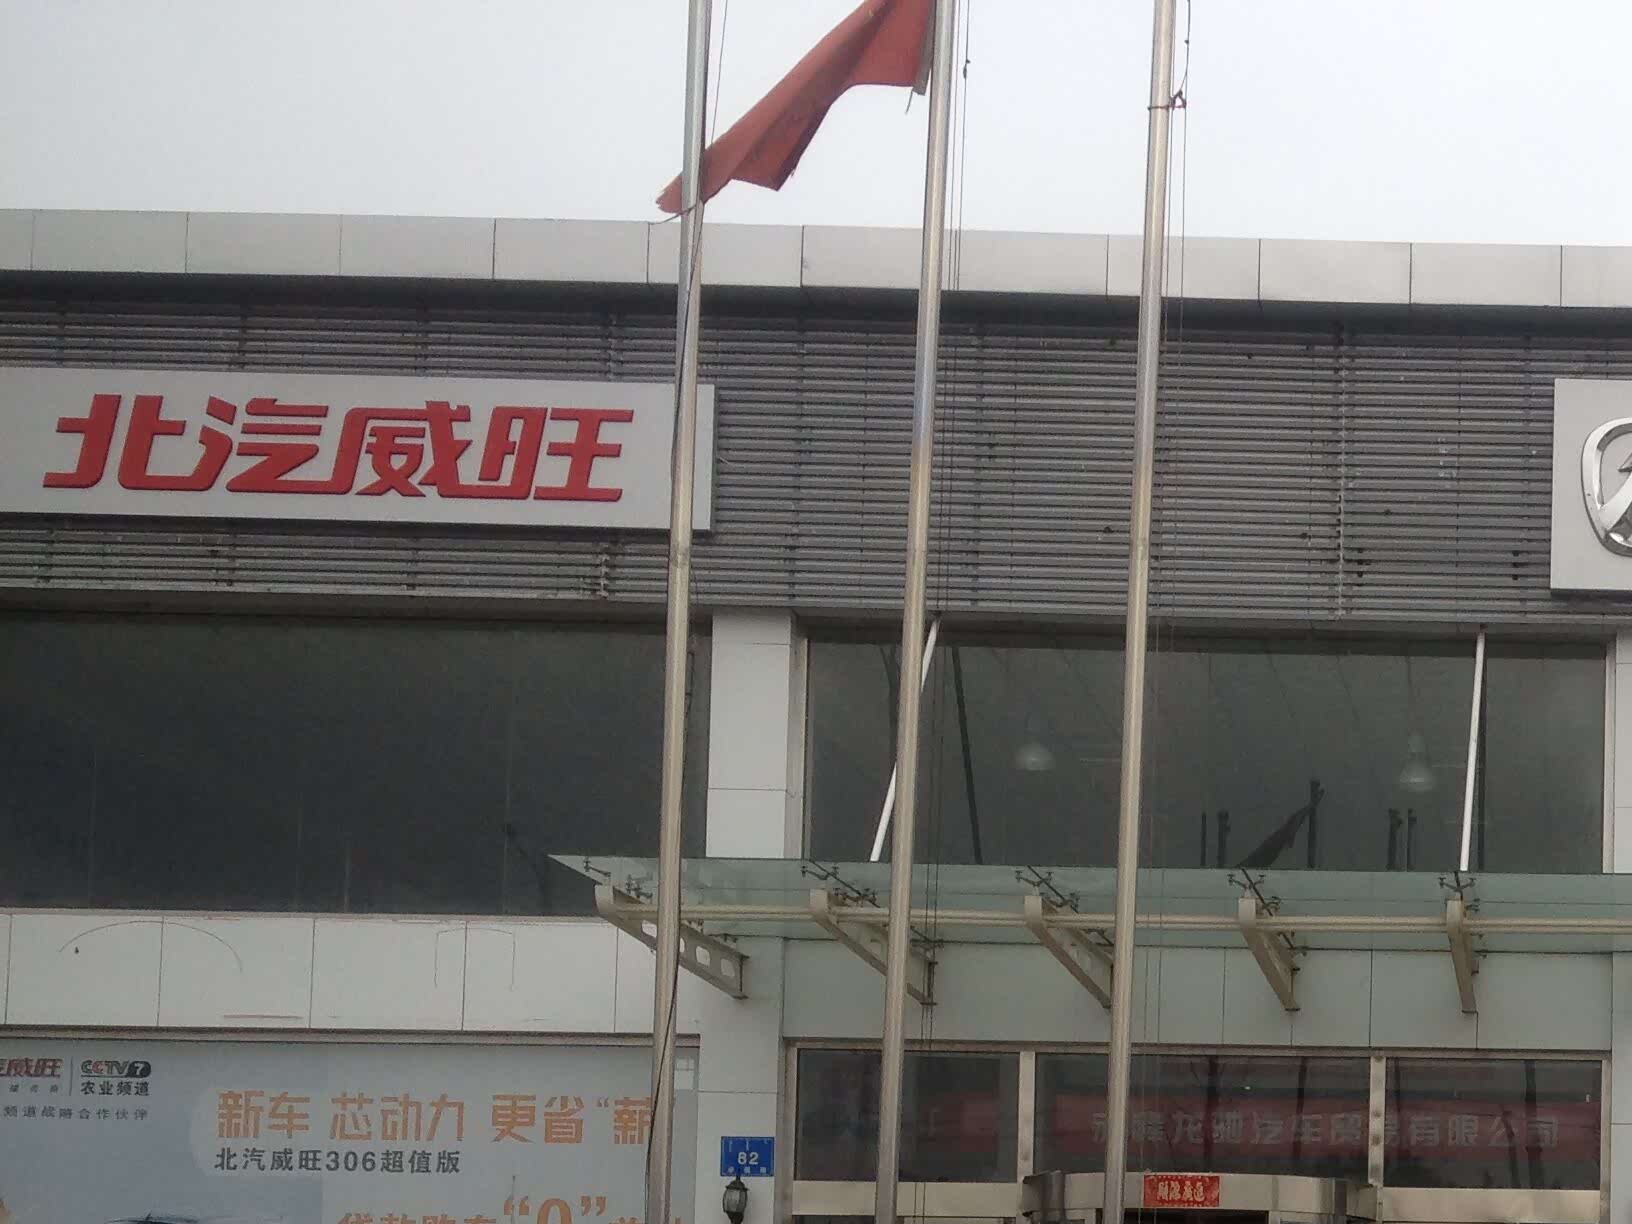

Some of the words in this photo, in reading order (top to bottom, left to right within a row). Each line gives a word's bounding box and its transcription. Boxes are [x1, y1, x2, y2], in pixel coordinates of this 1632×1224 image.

[42, 394, 634, 502] 北汽威旺
[81, 1081, 149, 1096] 农业频道
[217, 1090, 311, 1139] 新车
[330, 1092, 465, 1142] 芯动力
[215, 1147, 460, 1174] 北汽威旺306超值版
[738, 1152, 758, 1164] 82
